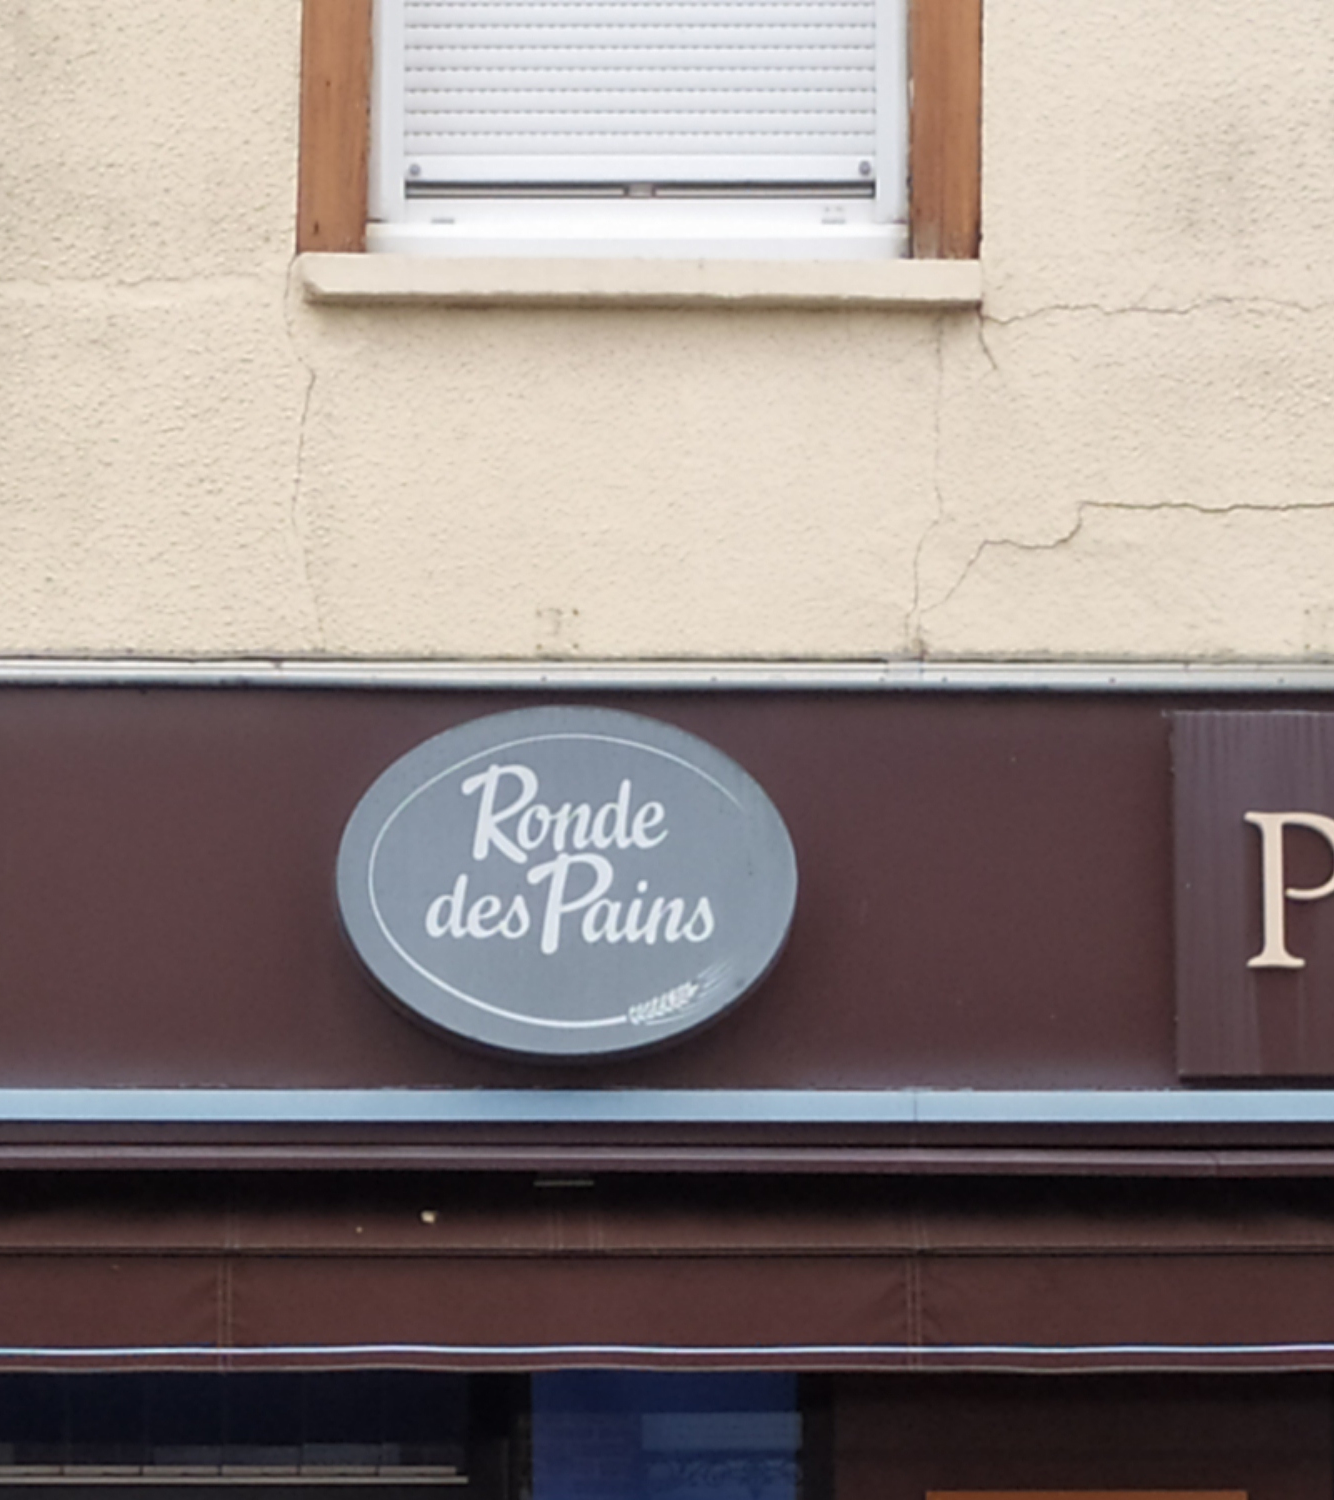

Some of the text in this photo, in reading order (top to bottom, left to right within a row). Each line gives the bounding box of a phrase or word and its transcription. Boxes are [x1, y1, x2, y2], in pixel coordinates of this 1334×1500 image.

[462, 763, 669, 863] Ronde
[425, 852, 714, 955] des Pains
